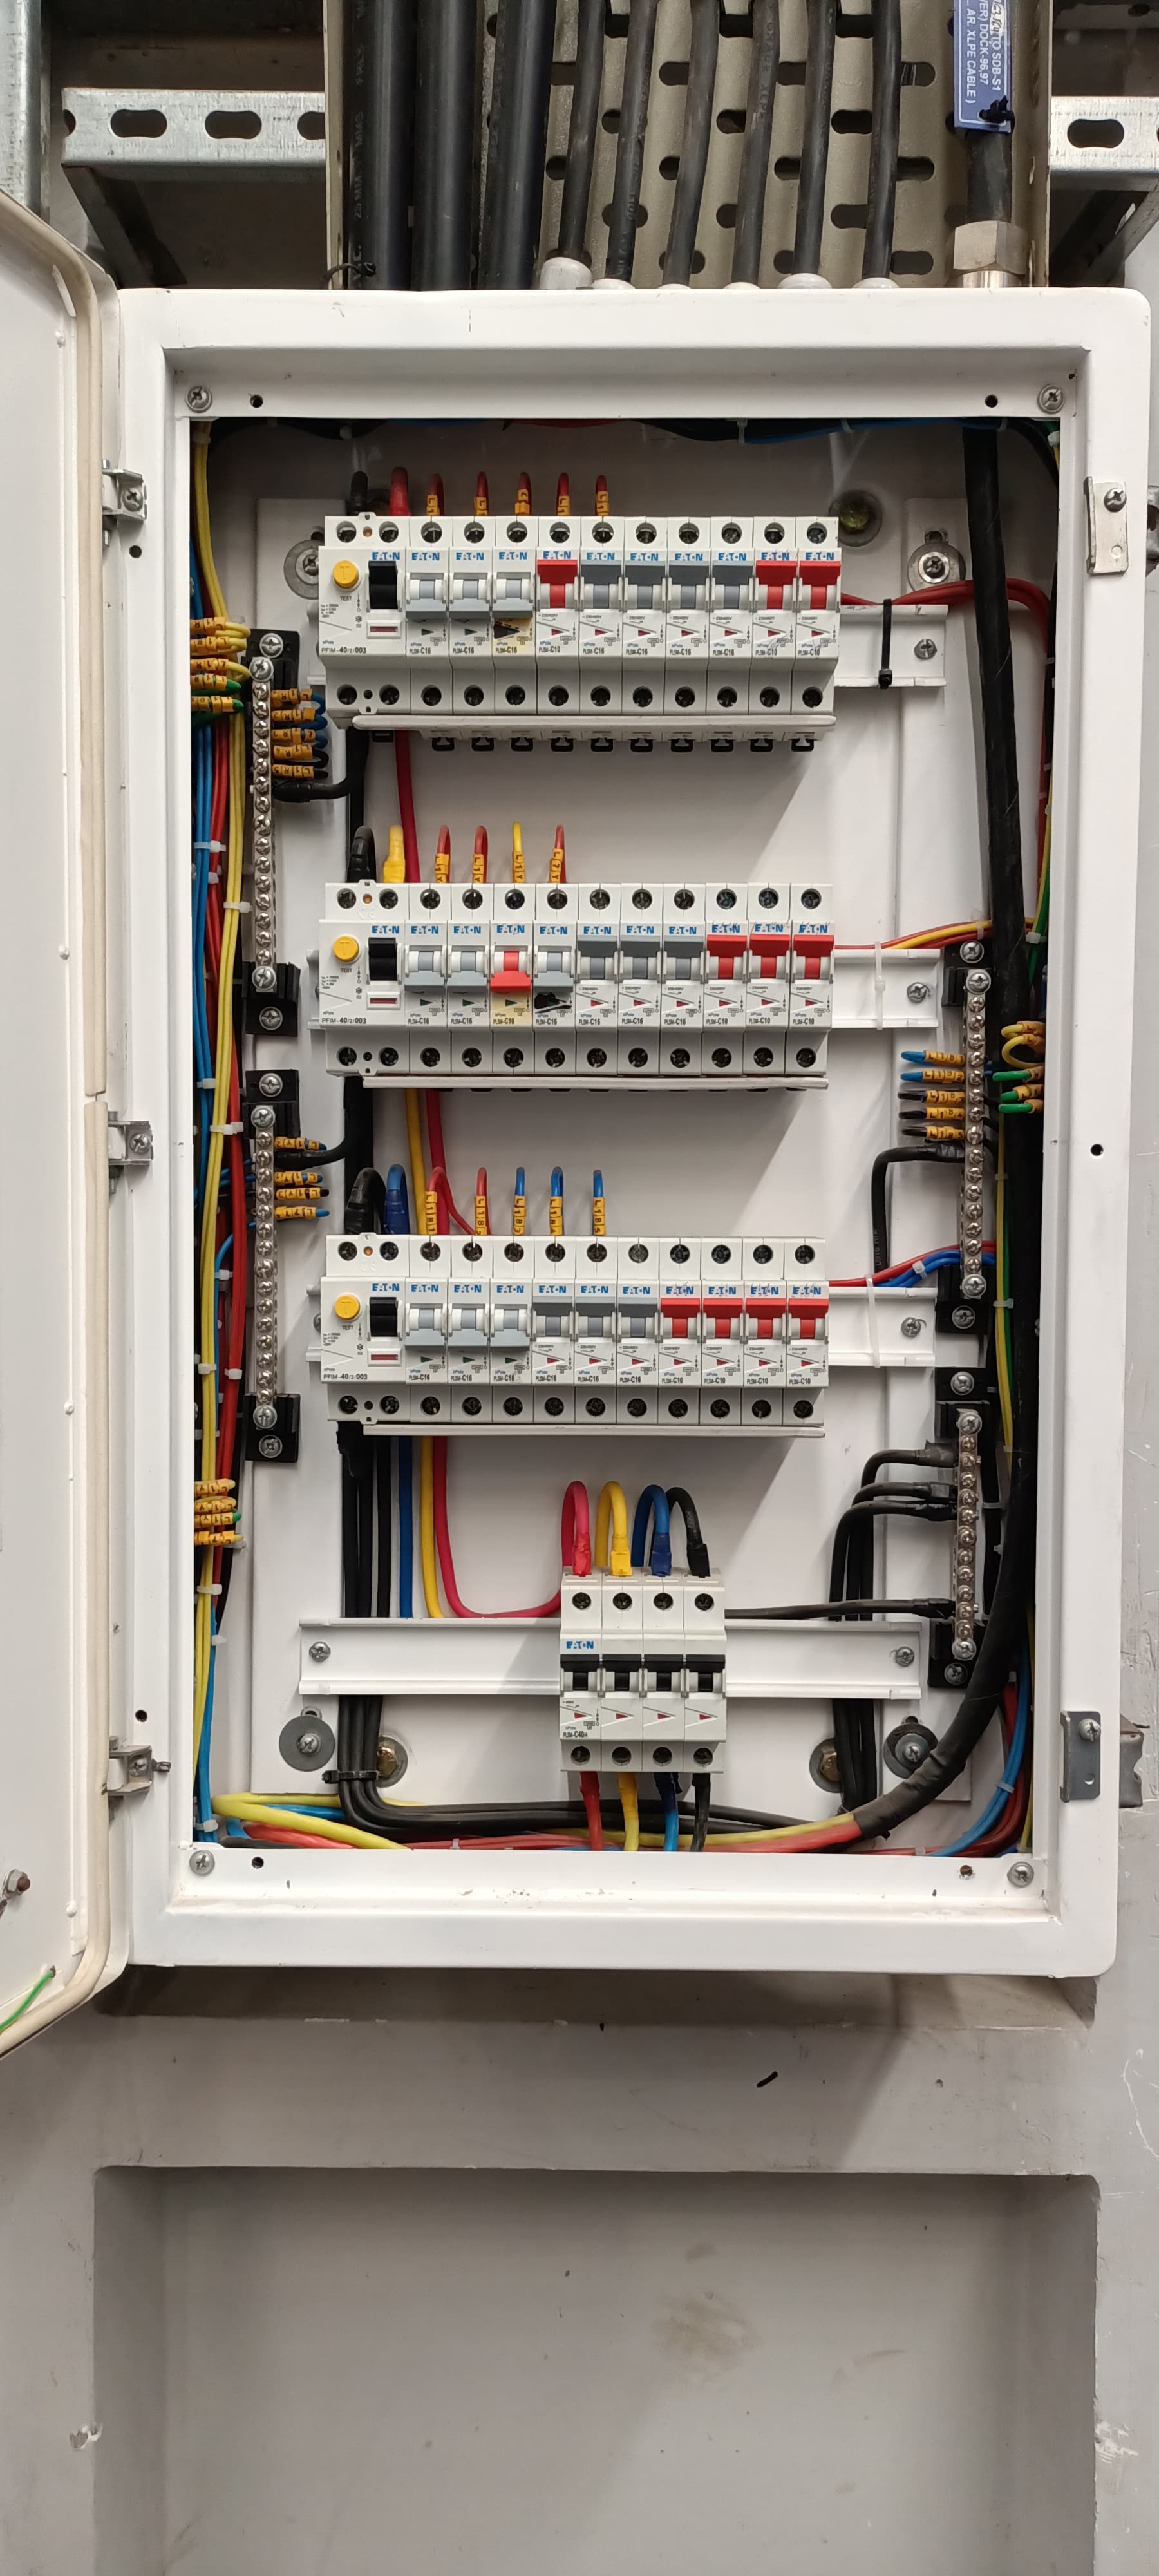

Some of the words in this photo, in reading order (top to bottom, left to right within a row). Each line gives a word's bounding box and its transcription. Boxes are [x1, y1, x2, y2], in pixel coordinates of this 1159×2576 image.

[967, 30, 975, 58] XLPE
[979, 24, 989, 85] DOCK-96,97
[992, 52, 1001, 90] SDB-S1
